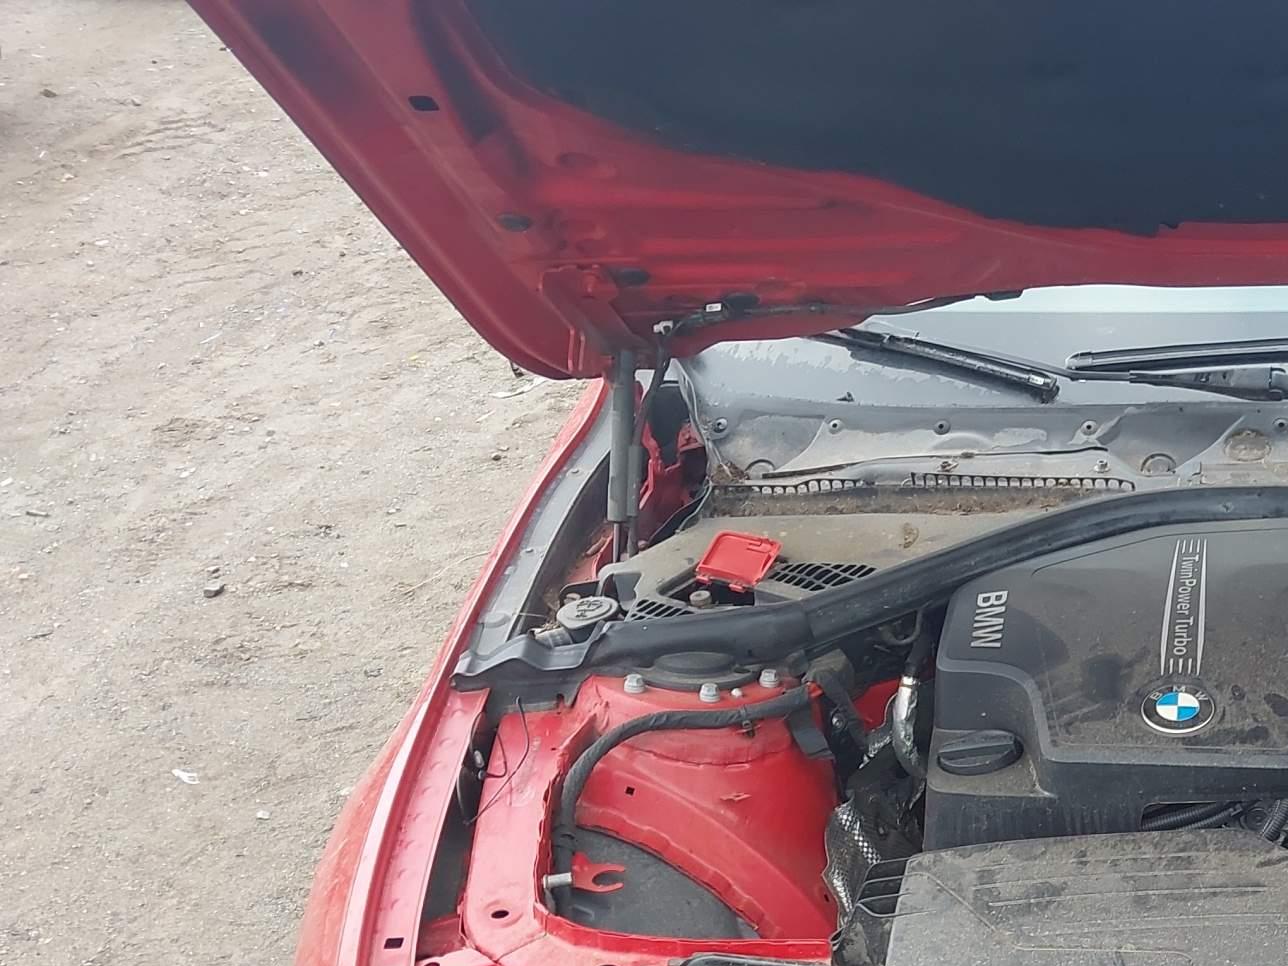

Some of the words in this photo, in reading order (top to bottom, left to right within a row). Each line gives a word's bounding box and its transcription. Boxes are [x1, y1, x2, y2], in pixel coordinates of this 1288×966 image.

[1176, 554, 1200, 616] TwinPower
[970, 590, 1009, 648] BMW
[1173, 616, 1194, 656] Turbo
[1150, 685, 1209, 701] BMW
